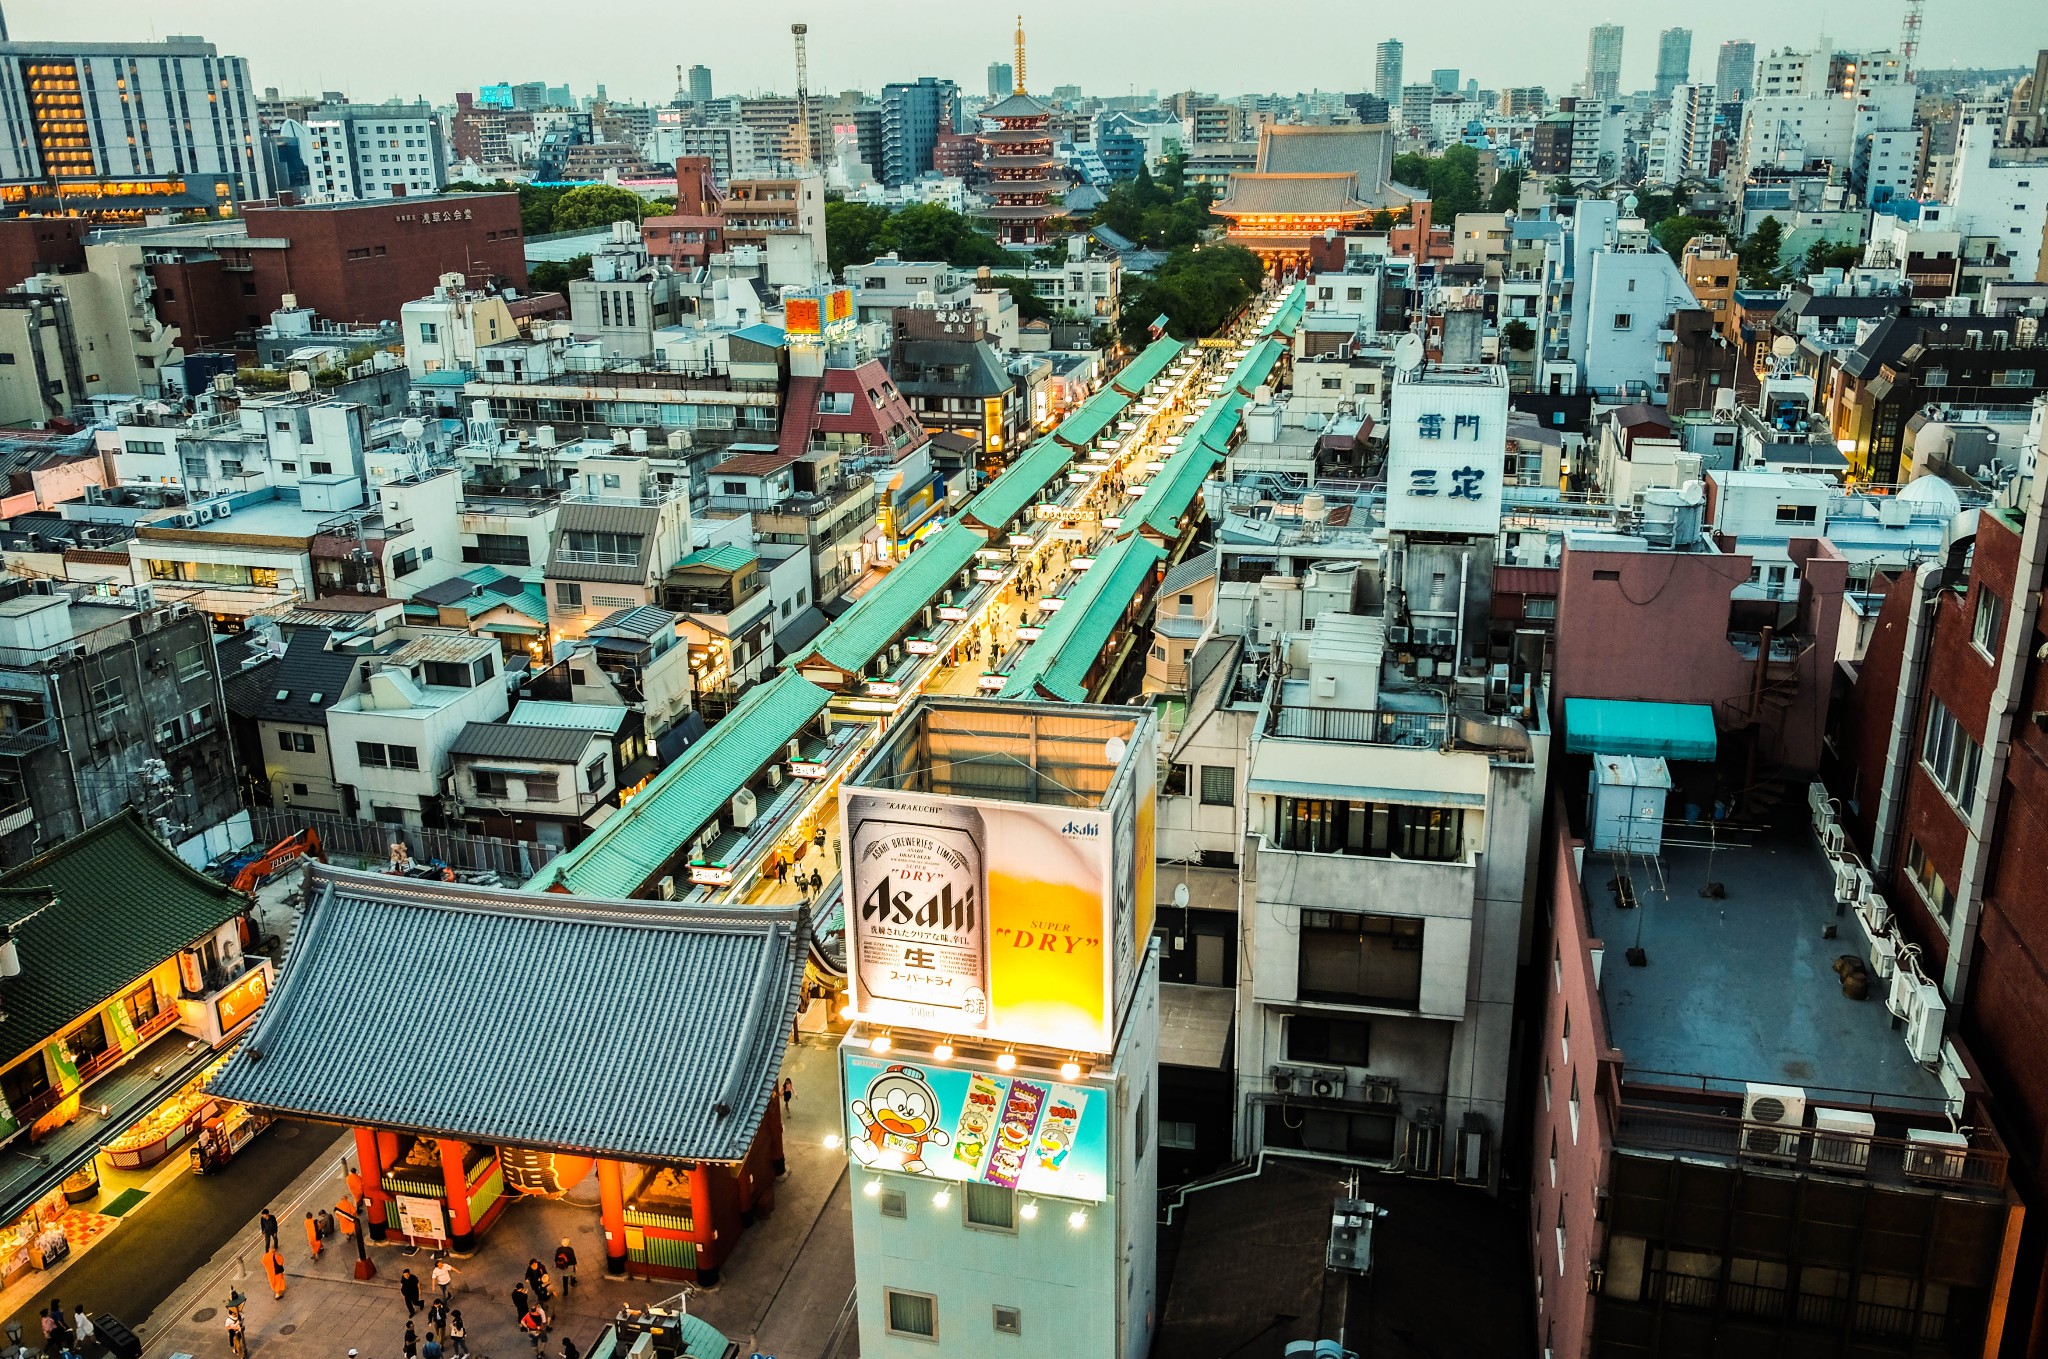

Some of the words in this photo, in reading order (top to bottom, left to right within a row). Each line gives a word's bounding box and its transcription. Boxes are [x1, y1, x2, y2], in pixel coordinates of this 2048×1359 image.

[421, 208, 472, 224] 浅草公会堂
[1417, 414, 1480, 441] 雷門
[1406, 466, 1485, 502] 三定
[1061, 821, 1099, 836] Asahi
[872, 842, 890, 861] ASAHI
[891, 836, 934, 851] BREWERIES
[936, 845, 961, 870] LIMITED
[862, 875, 975, 934] Asahi
[1030, 920, 1071, 932] SUPER
[904, 948, 936, 970] 生
[890, 970, 953, 987] スーパードライ
